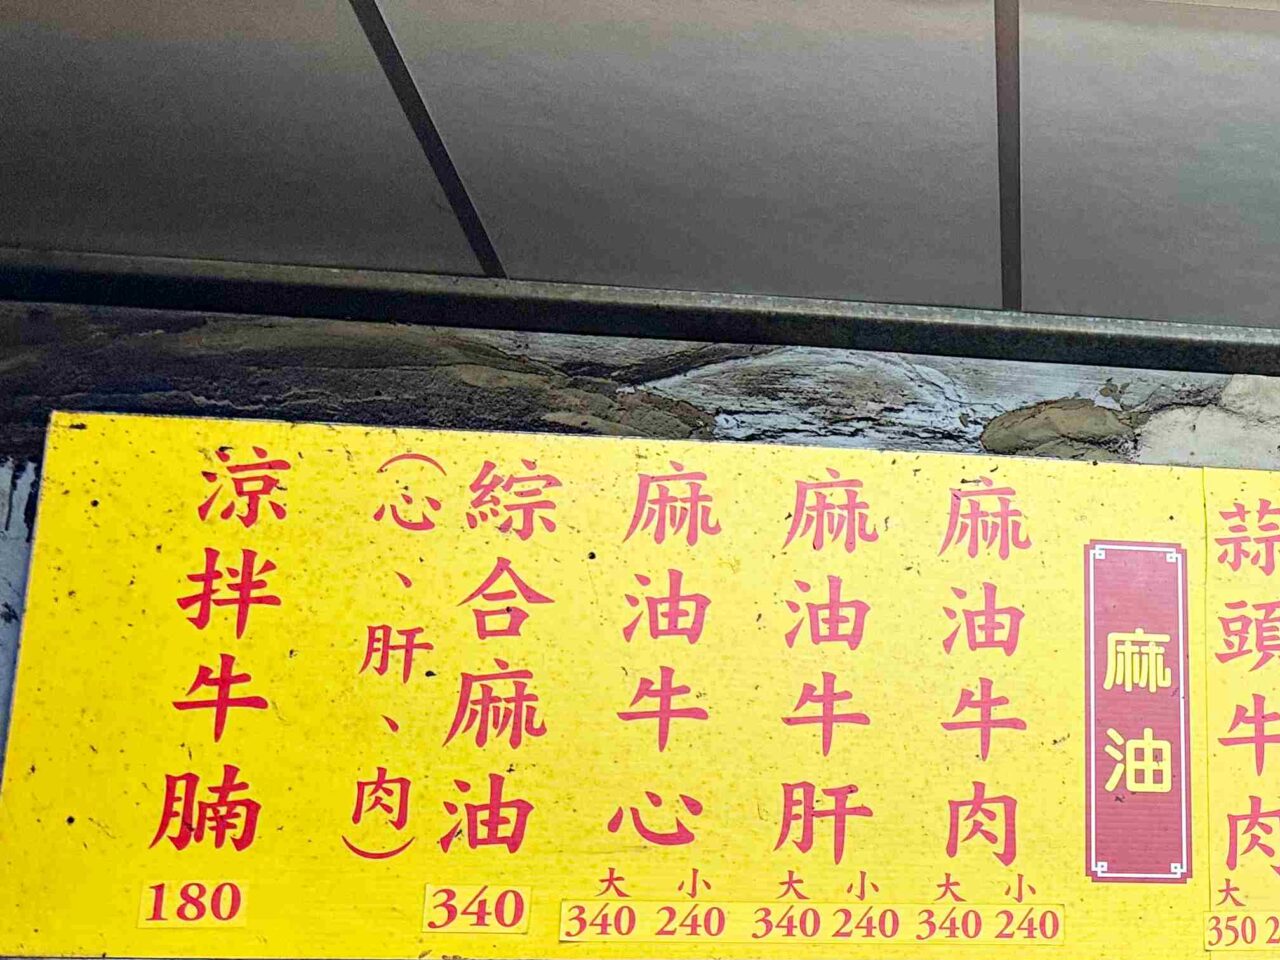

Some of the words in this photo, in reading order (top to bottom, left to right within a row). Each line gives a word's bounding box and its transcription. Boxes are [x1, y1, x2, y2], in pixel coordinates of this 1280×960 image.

[148, 446, 292, 853] 涼拌牛腩
[438, 458, 562, 854] 綜合麻油
[607, 462, 721, 847] 麻油牛心
[775, 468, 878, 864] 麻油牛肝
[941, 478, 1031, 867] 麻油牛肉
[1103, 628, 1172, 794] 麻油
[599, 867, 629, 898] 大
[677, 868, 712, 899] 小
[781, 870, 808, 900] 大
[847, 871, 879, 901] 小
[936, 872, 963, 902] 大
[1005, 874, 1036, 903] 小
[1217, 880, 1246, 907] 大
[147, 882, 241, 922] 180
[428, 886, 525, 929] 340
[565, 905, 636, 937] 340
[656, 905, 725, 936] 240
[752, 907, 821, 939] 340
[833, 908, 900, 938] 240
[916, 908, 982, 940] 340
[996, 910, 1059, 939] 240
[1208, 916, 1256, 944] 350
